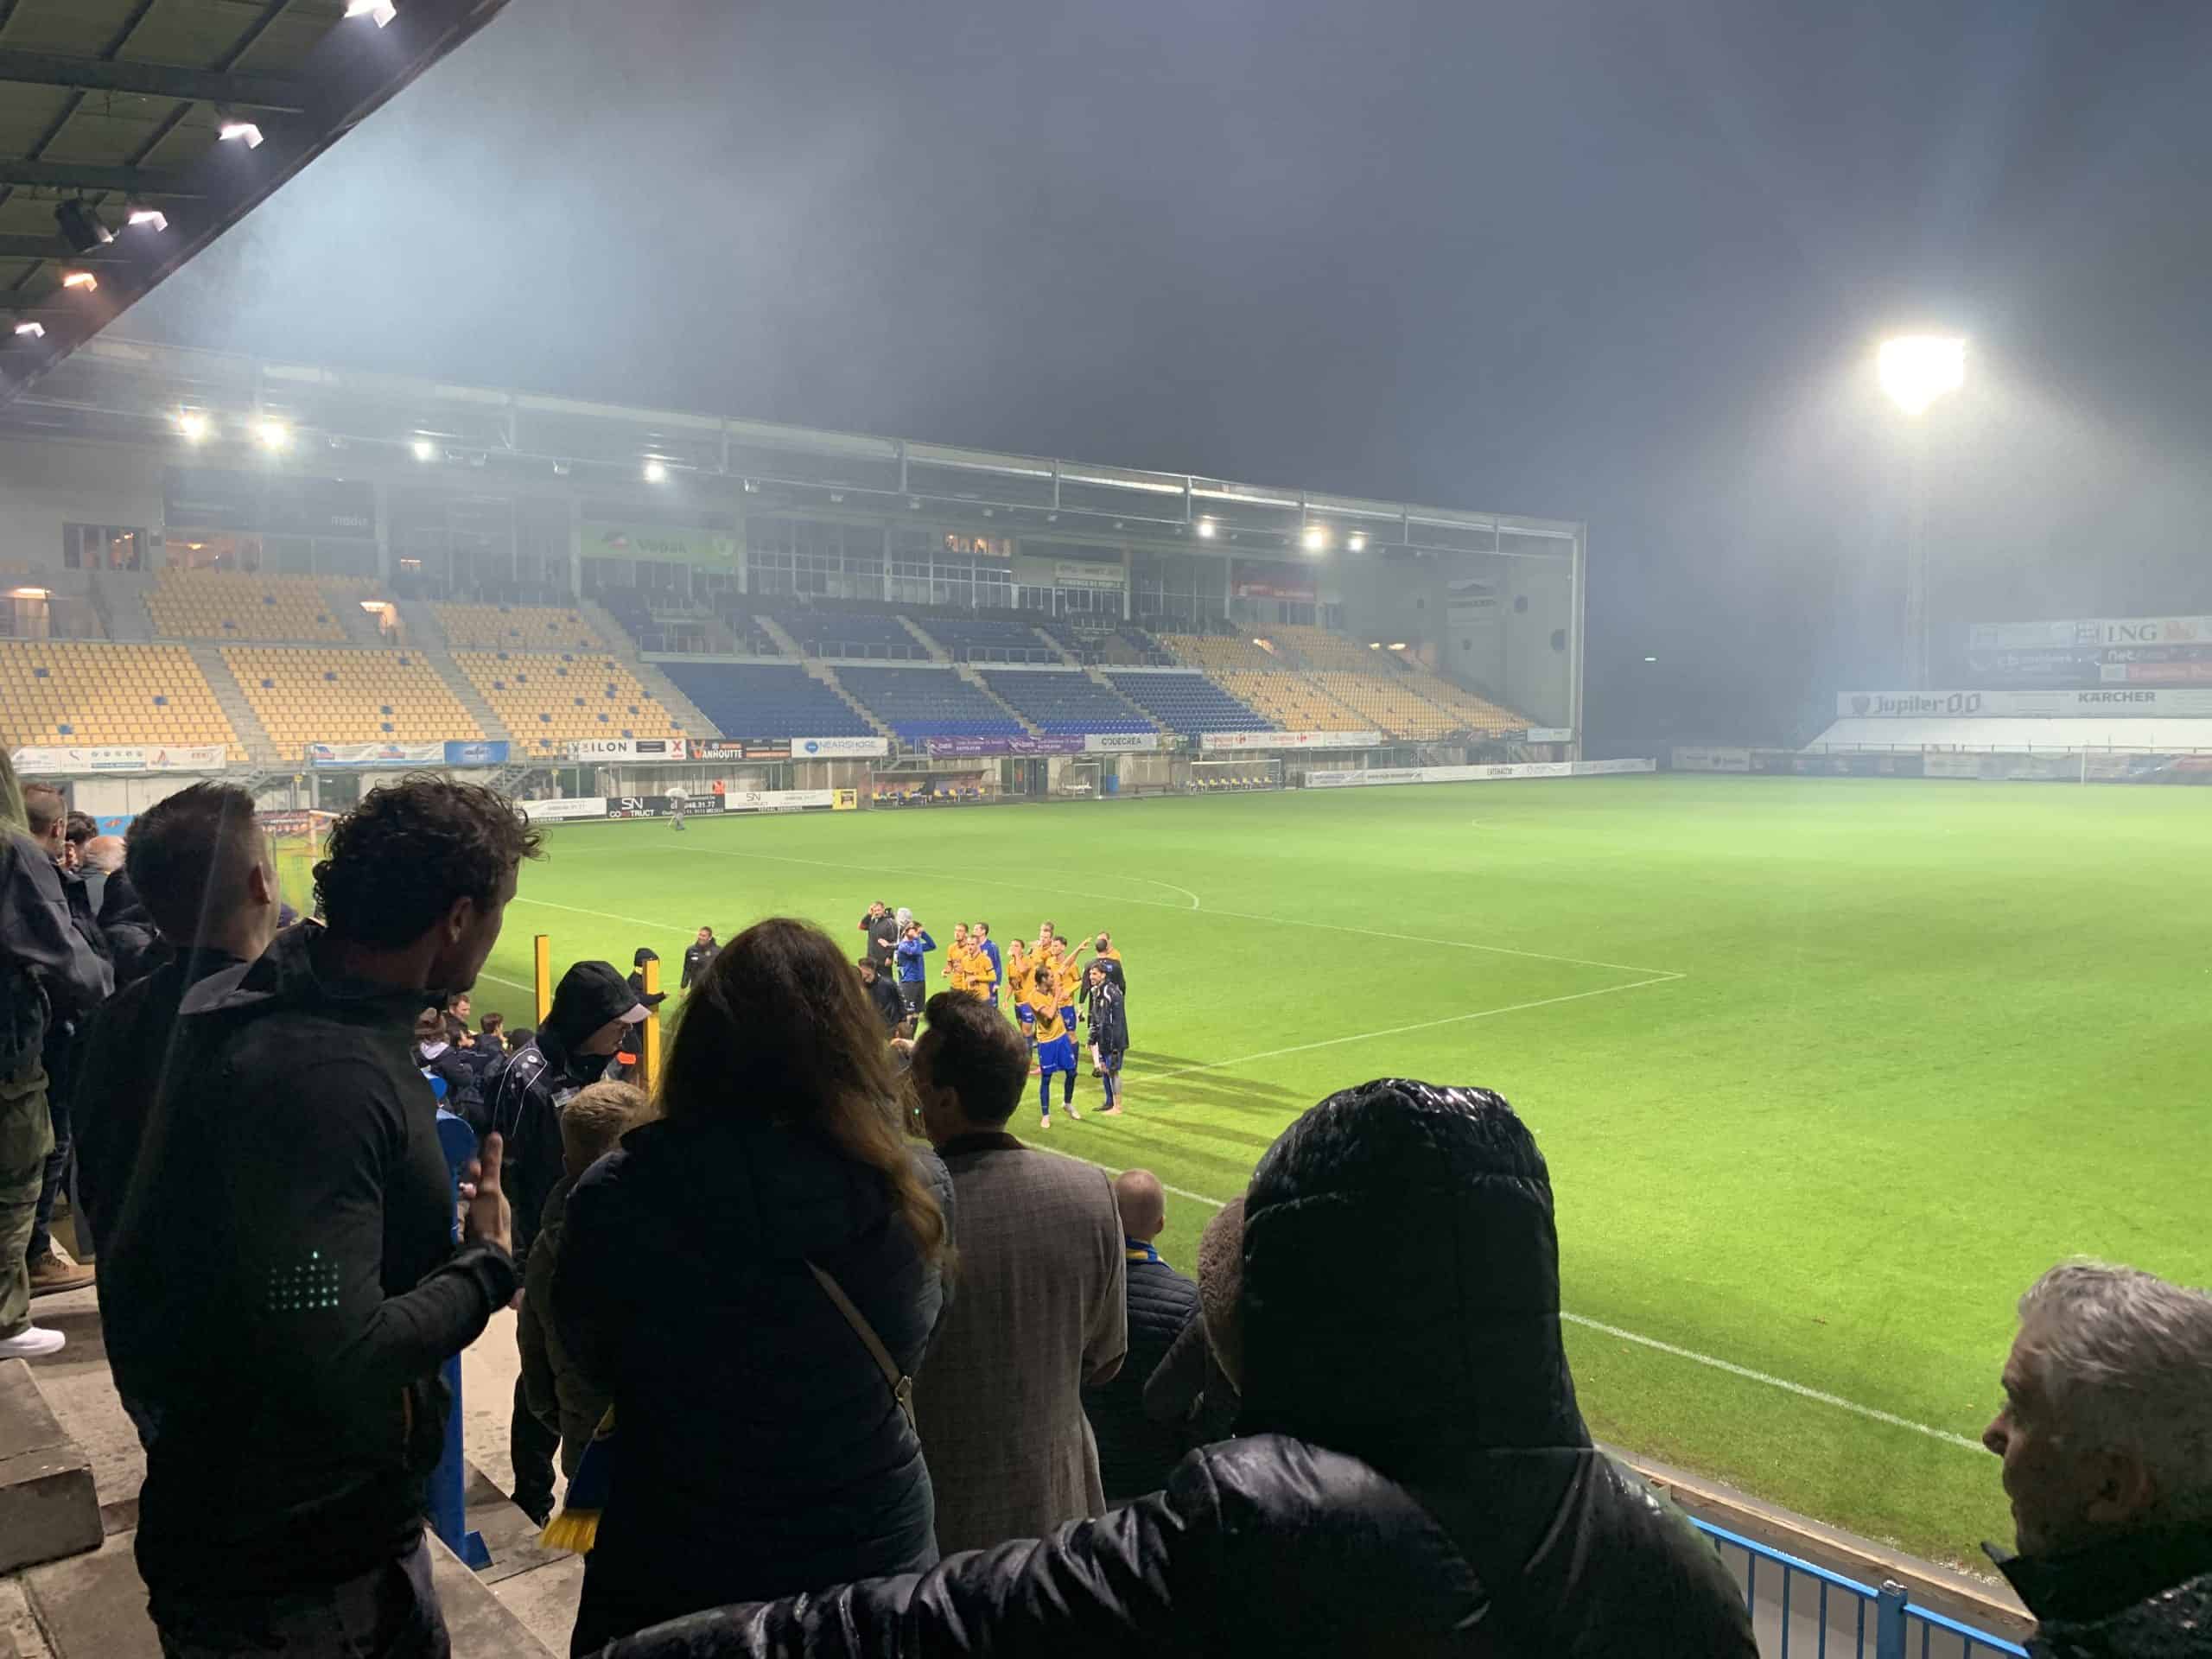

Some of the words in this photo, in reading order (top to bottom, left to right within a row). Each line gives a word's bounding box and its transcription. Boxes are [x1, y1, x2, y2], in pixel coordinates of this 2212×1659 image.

[2107, 623, 2158, 642] ING
[1873, 695, 1943, 717] Jupiler
[621, 797, 643, 810] SN
